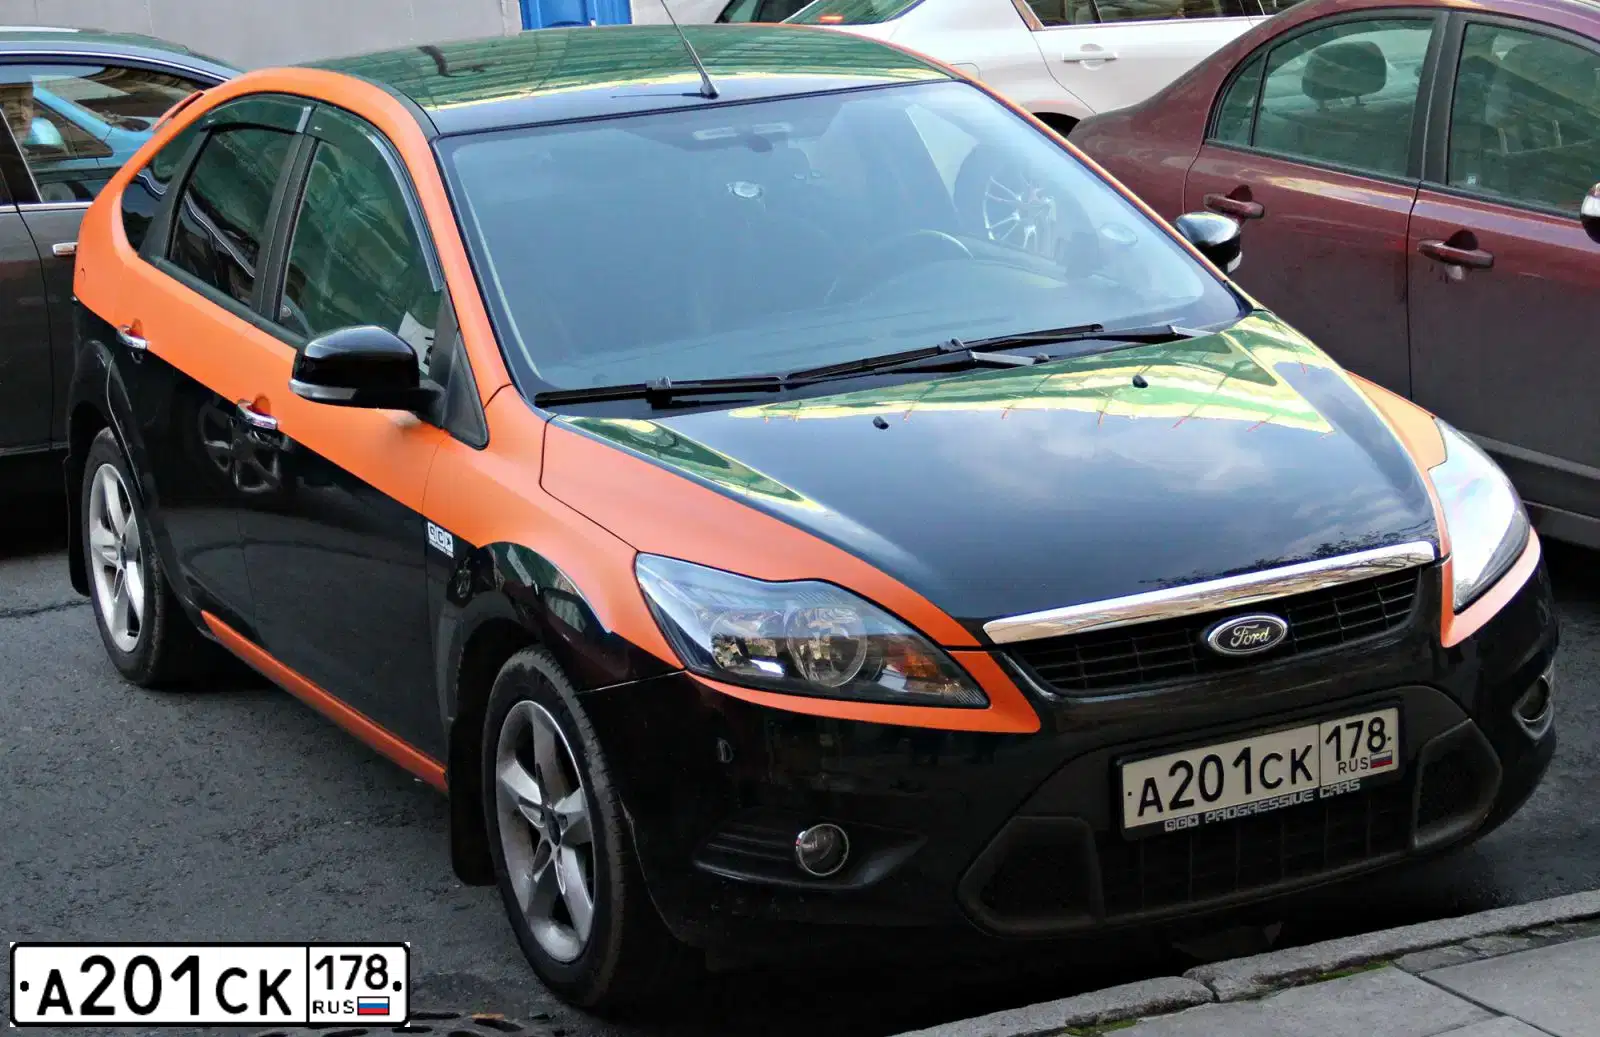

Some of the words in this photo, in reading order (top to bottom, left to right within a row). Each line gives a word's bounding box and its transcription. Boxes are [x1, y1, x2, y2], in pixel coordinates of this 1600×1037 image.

[1230, 623, 1270, 647] Ford
[1137, 746, 1313, 817] A201CK
[1325, 716, 1386, 762] 178
[1337, 756, 1369, 775] RUS
[1205, 789, 1314, 824] PROGRESSIVE
[1319, 779, 1361, 799] CARS
